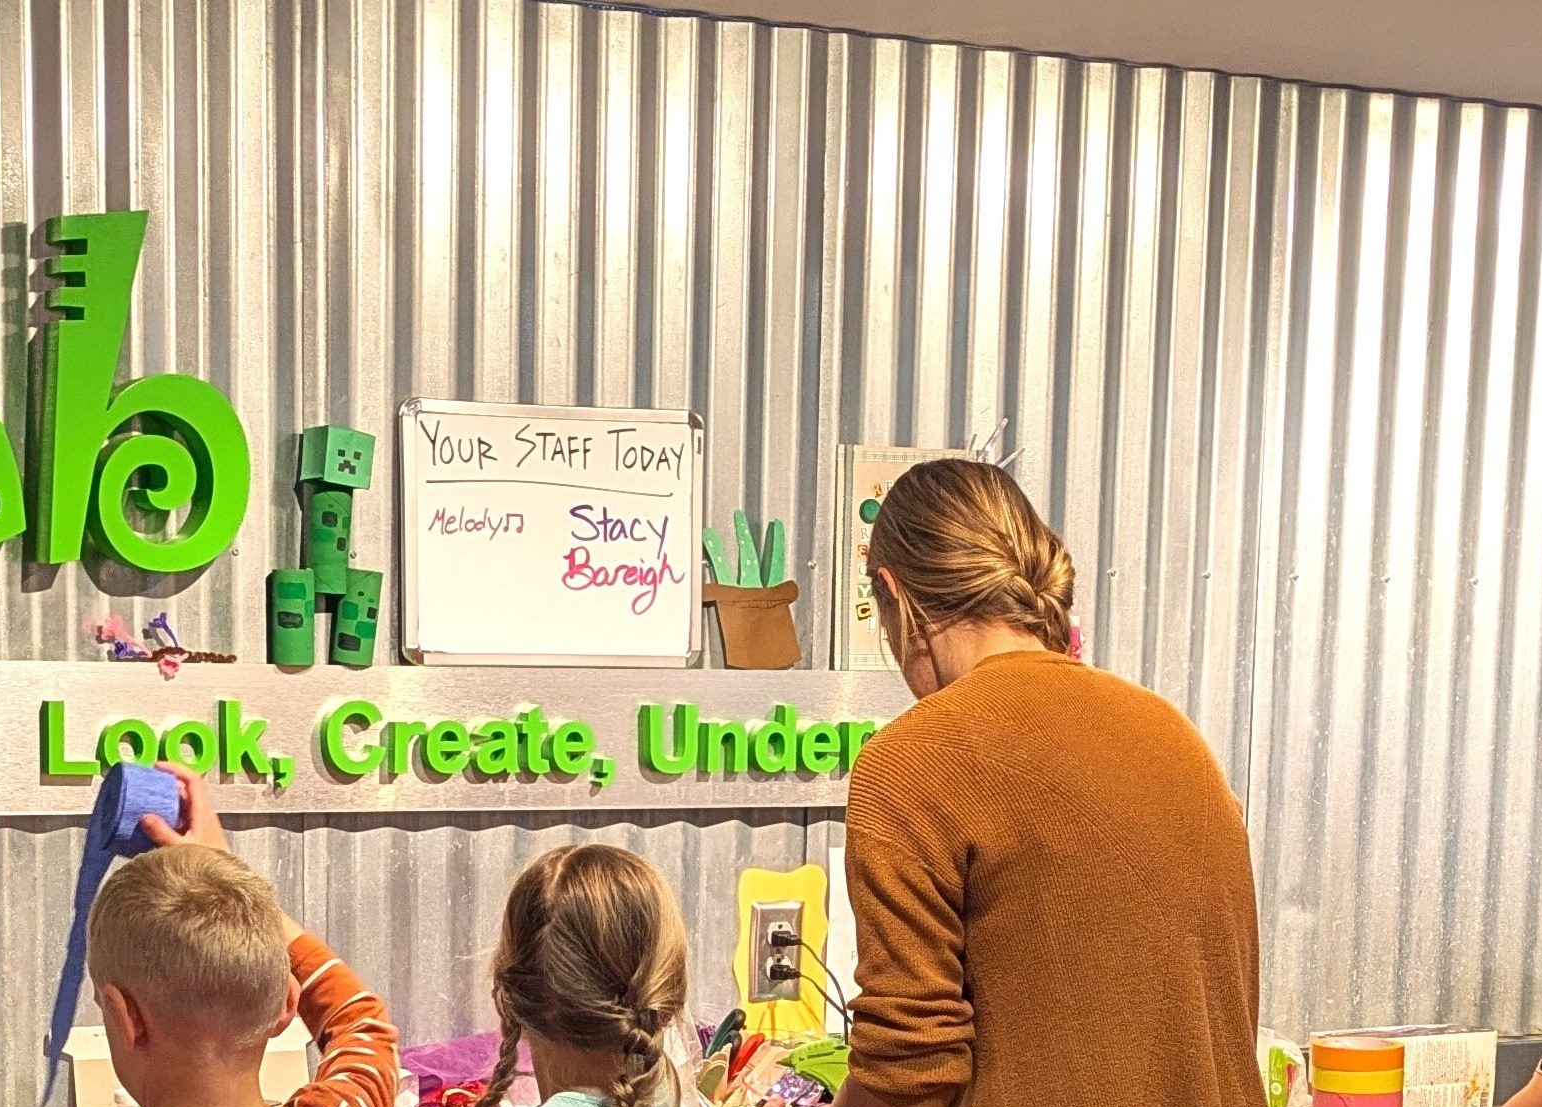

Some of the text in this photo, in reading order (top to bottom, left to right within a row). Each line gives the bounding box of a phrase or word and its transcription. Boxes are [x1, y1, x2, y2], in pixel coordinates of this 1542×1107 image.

[419, 420, 685, 480] YOUR STAFF TODAY
[428, 506, 504, 541] Melody
[569, 504, 669, 560] Stacy
[39, 699, 295, 788] Look,
[321, 699, 615, 788] Create,
